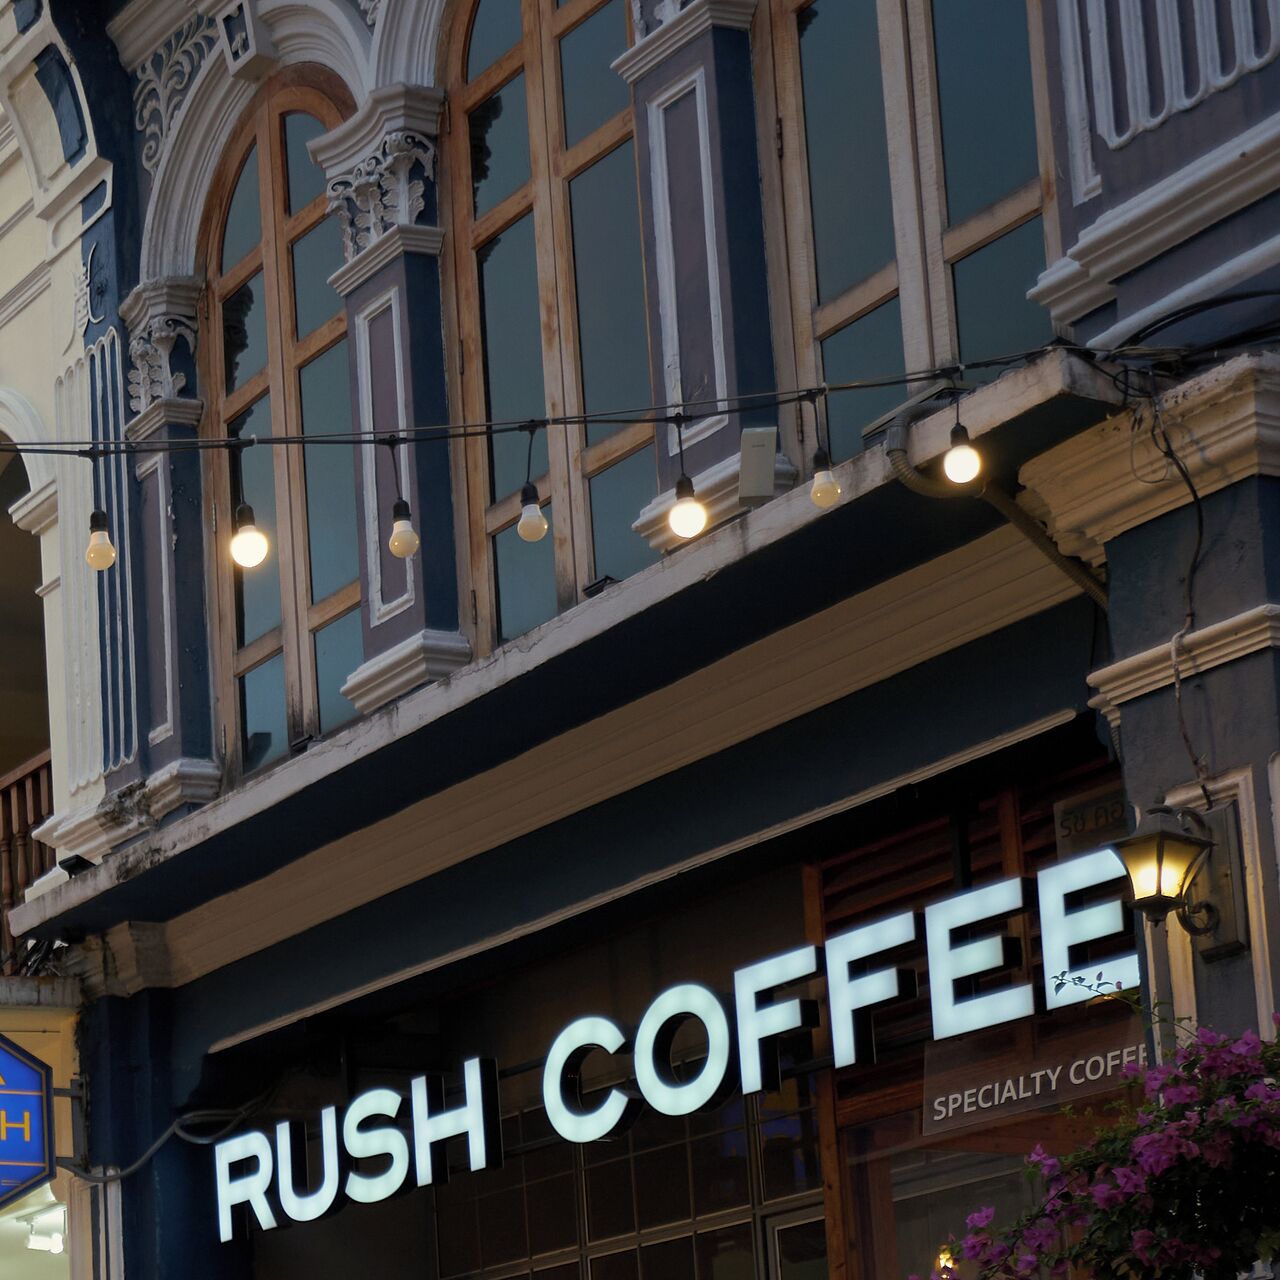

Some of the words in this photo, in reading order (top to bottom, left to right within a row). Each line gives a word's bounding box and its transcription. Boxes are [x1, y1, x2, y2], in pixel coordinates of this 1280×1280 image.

[215, 1058, 486, 1243] RUSH
[542, 849, 1140, 1143] COFFEE
[933, 1065, 1062, 1121] SPECIALTY
